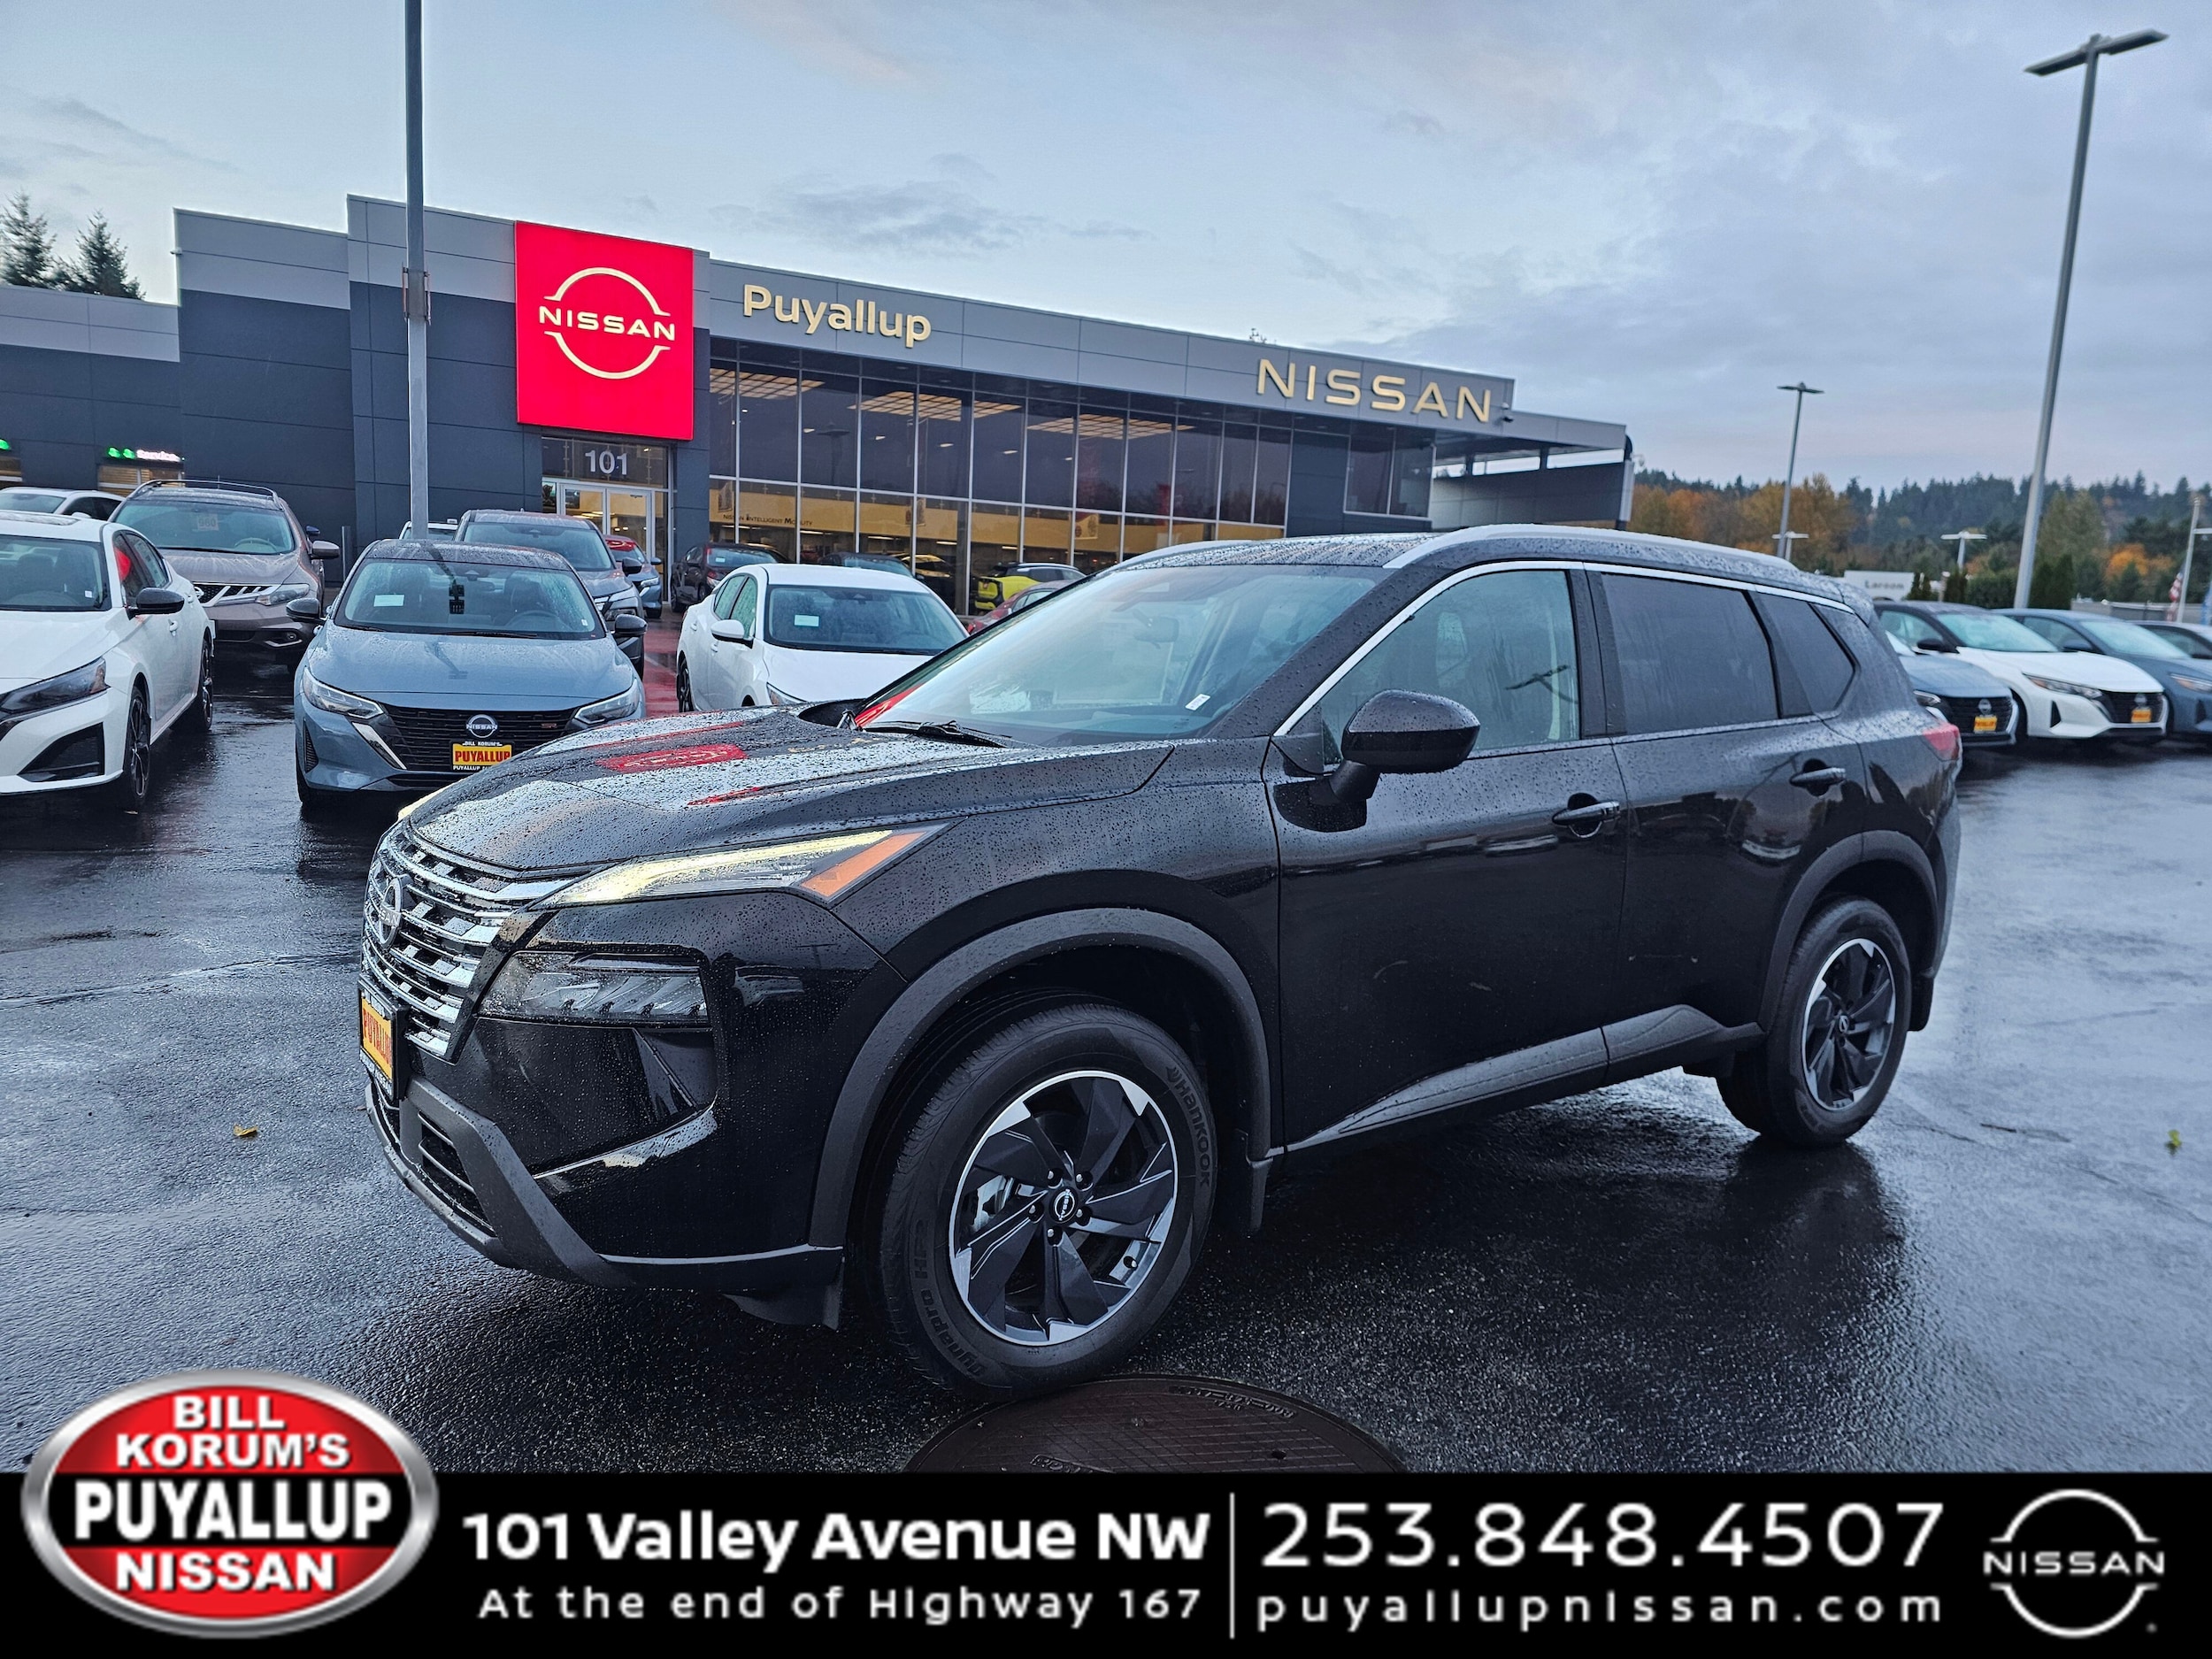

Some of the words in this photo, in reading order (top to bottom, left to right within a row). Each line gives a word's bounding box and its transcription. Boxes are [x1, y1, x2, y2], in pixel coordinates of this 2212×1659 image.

[539, 305, 675, 341] NISSAN
[743, 284, 932, 349] Puyallup
[1256, 358, 1492, 423] NISSAN
[585, 449, 627, 475] 101
[455, 750, 511, 763] PUYALLUP
